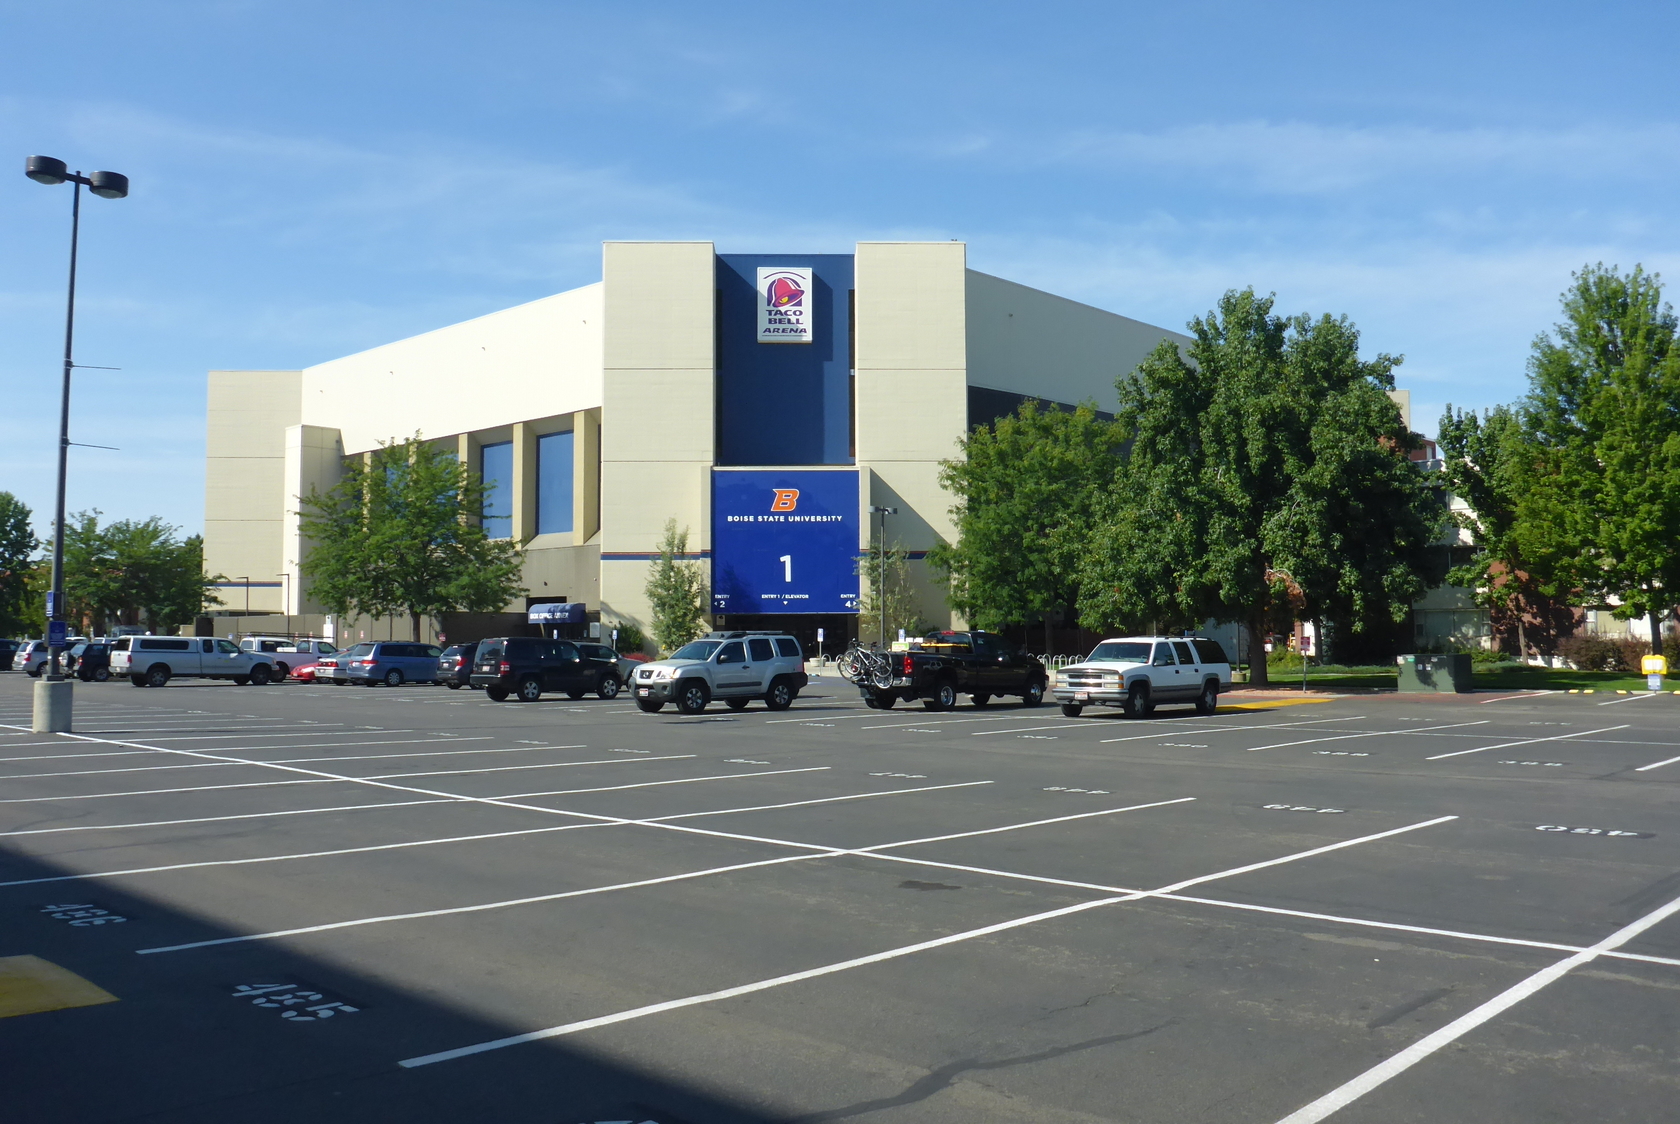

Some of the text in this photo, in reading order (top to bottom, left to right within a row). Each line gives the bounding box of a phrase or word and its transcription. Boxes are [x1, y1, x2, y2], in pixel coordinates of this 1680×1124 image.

[766, 309, 803, 317] TACO
[770, 488, 800, 512] B
[779, 554, 792, 583] 1
[719, 600, 726, 608] 2
[844, 600, 851, 608] 4
[232, 983, 360, 1021] 485
